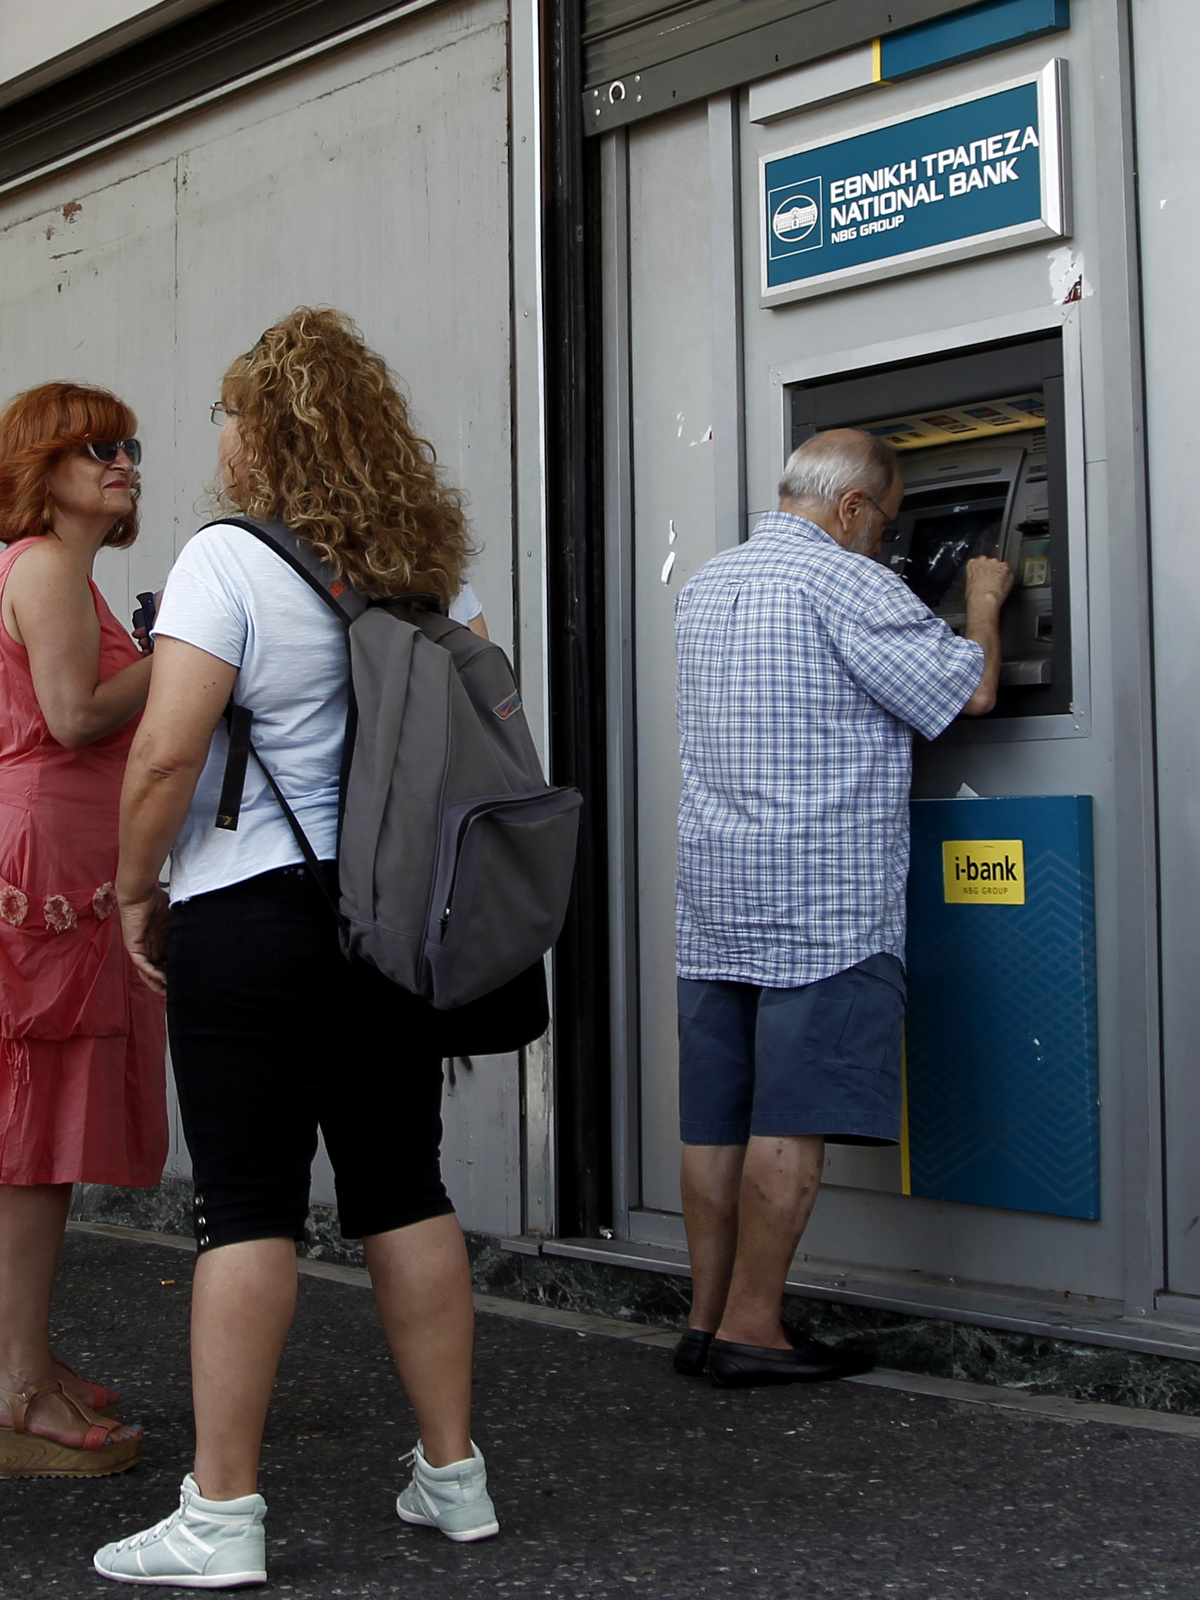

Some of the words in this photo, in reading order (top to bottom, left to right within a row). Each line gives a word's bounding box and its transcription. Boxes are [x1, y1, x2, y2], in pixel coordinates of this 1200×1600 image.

[830, 159, 917, 203] ΕΘΝΙΚΗ
[921, 126, 1040, 178] ΤΡΑΠΕΖΑ
[830, 187, 944, 229] NATIONAL
[949, 157, 1019, 198] BANK
[831, 224, 857, 244] NBG
[860, 214, 905, 237] GROUP
[955, 855, 1017, 881] i-bank
[963, 887, 979, 895] NBG
[982, 887, 1008, 895] GROUP
